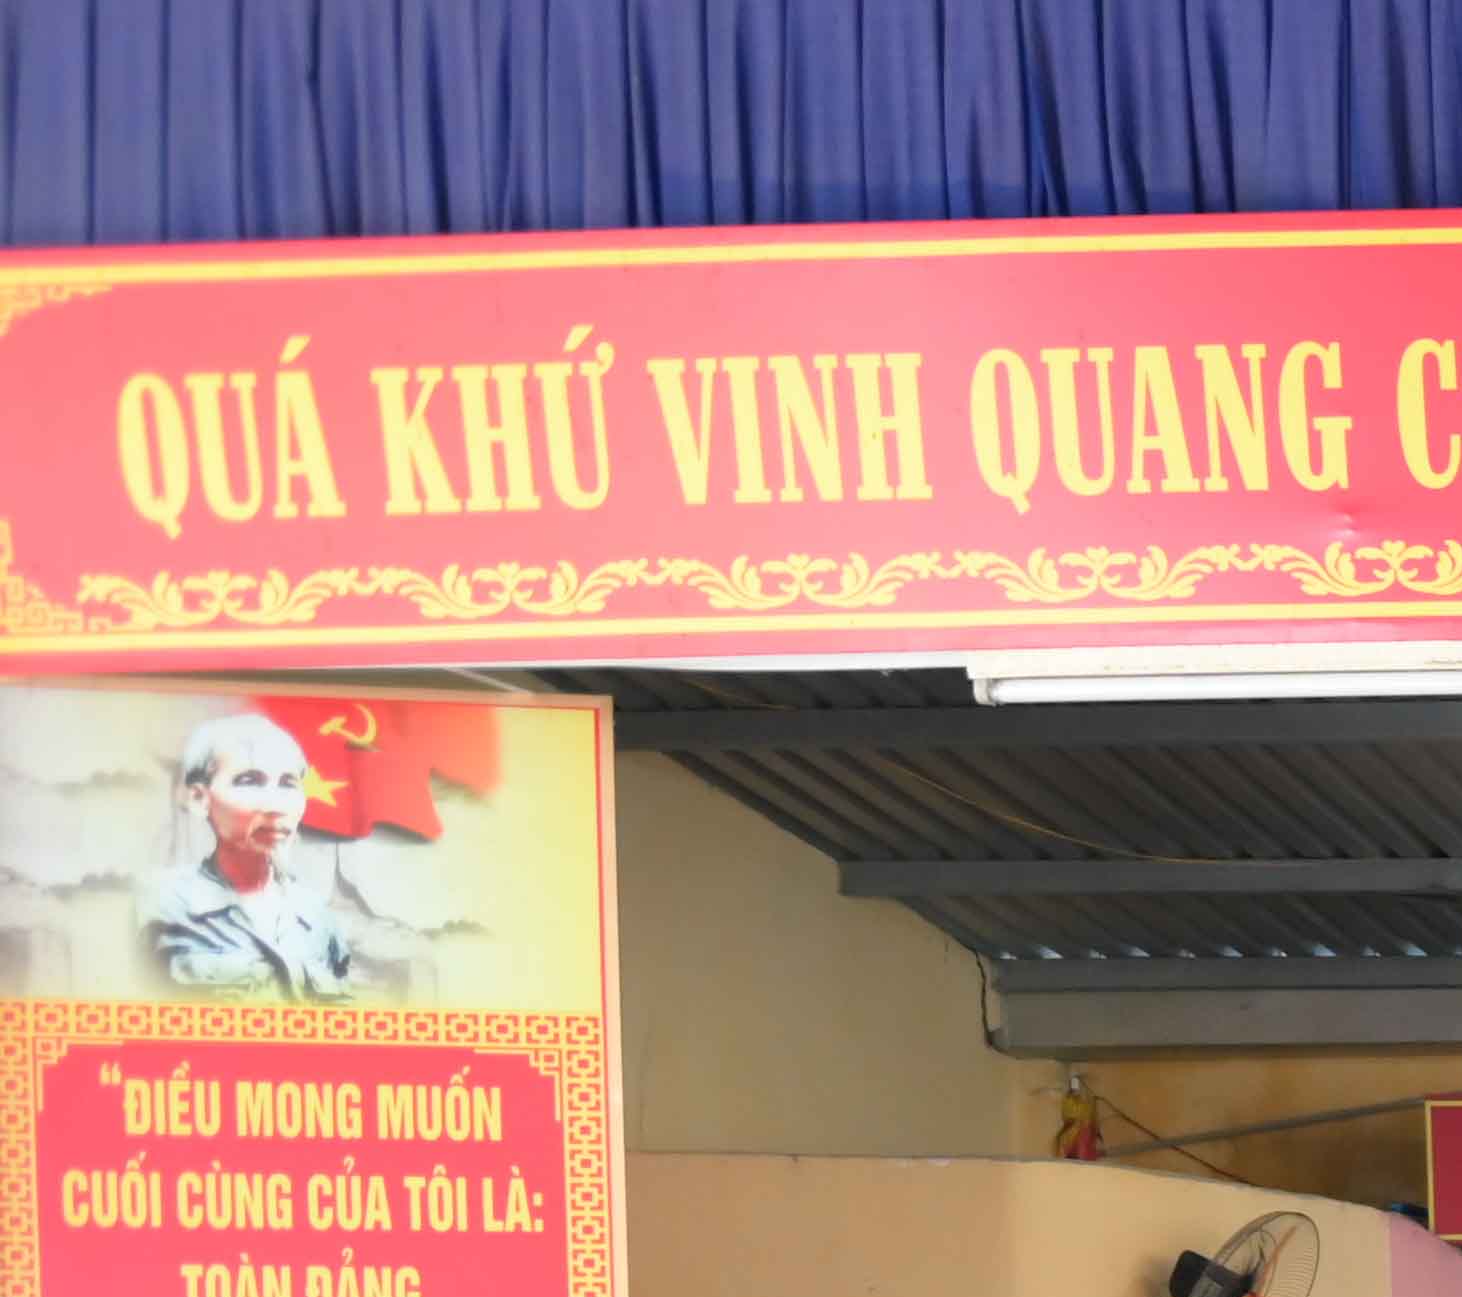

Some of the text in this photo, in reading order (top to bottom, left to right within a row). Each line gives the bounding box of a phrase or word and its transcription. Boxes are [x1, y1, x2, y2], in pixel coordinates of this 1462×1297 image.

[118, 336, 346, 539] QUÁ
[371, 325, 614, 515] KHỨ
[647, 353, 932, 504] VINH
[970, 342, 1352, 515] QUANG
[237, 1082, 362, 1139] MONG
[377, 1066, 501, 1141] MUỐN
[63, 1152, 544, 1232] CUỐI CÙNG CỦA TÔI LÀ:
